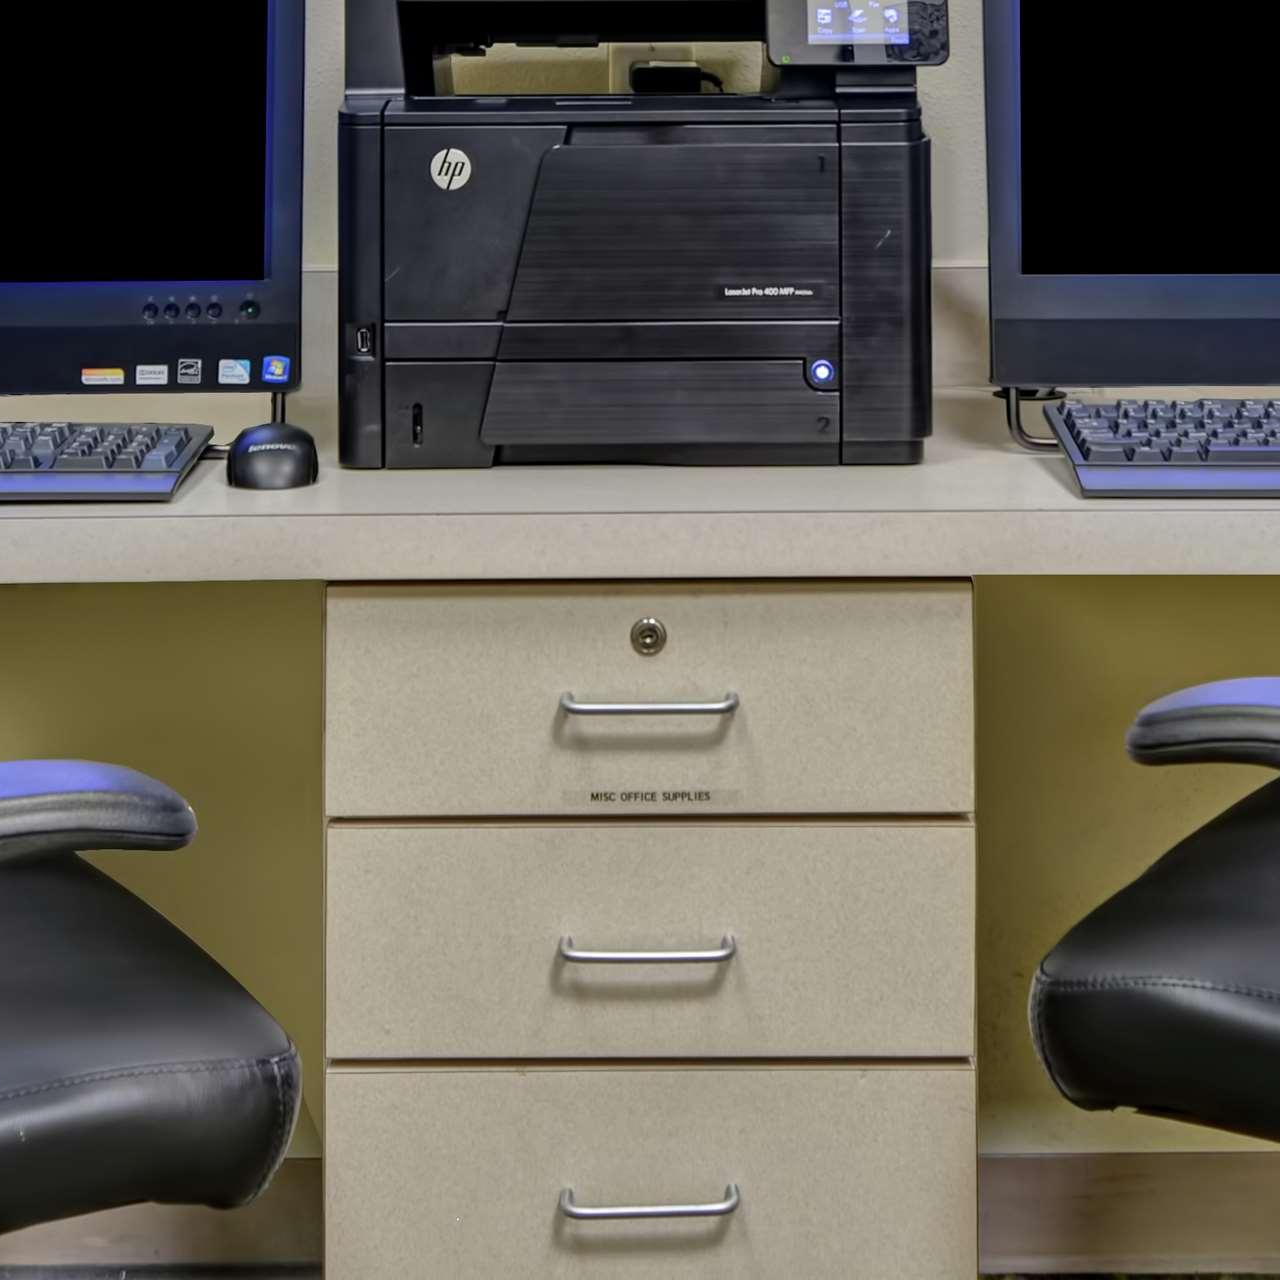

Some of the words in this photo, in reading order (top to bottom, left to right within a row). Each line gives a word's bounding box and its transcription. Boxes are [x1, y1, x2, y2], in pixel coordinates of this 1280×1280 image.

[437, 148, 465, 191] hp
[817, 156, 826, 174] 1
[751, 287, 763, 296] Pro
[764, 287, 779, 296] 400
[816, 417, 830, 434] 2
[590, 792, 617, 803] MISC
[620, 791, 657, 803] OFFICE
[662, 791, 711, 803] SUPPLIES
